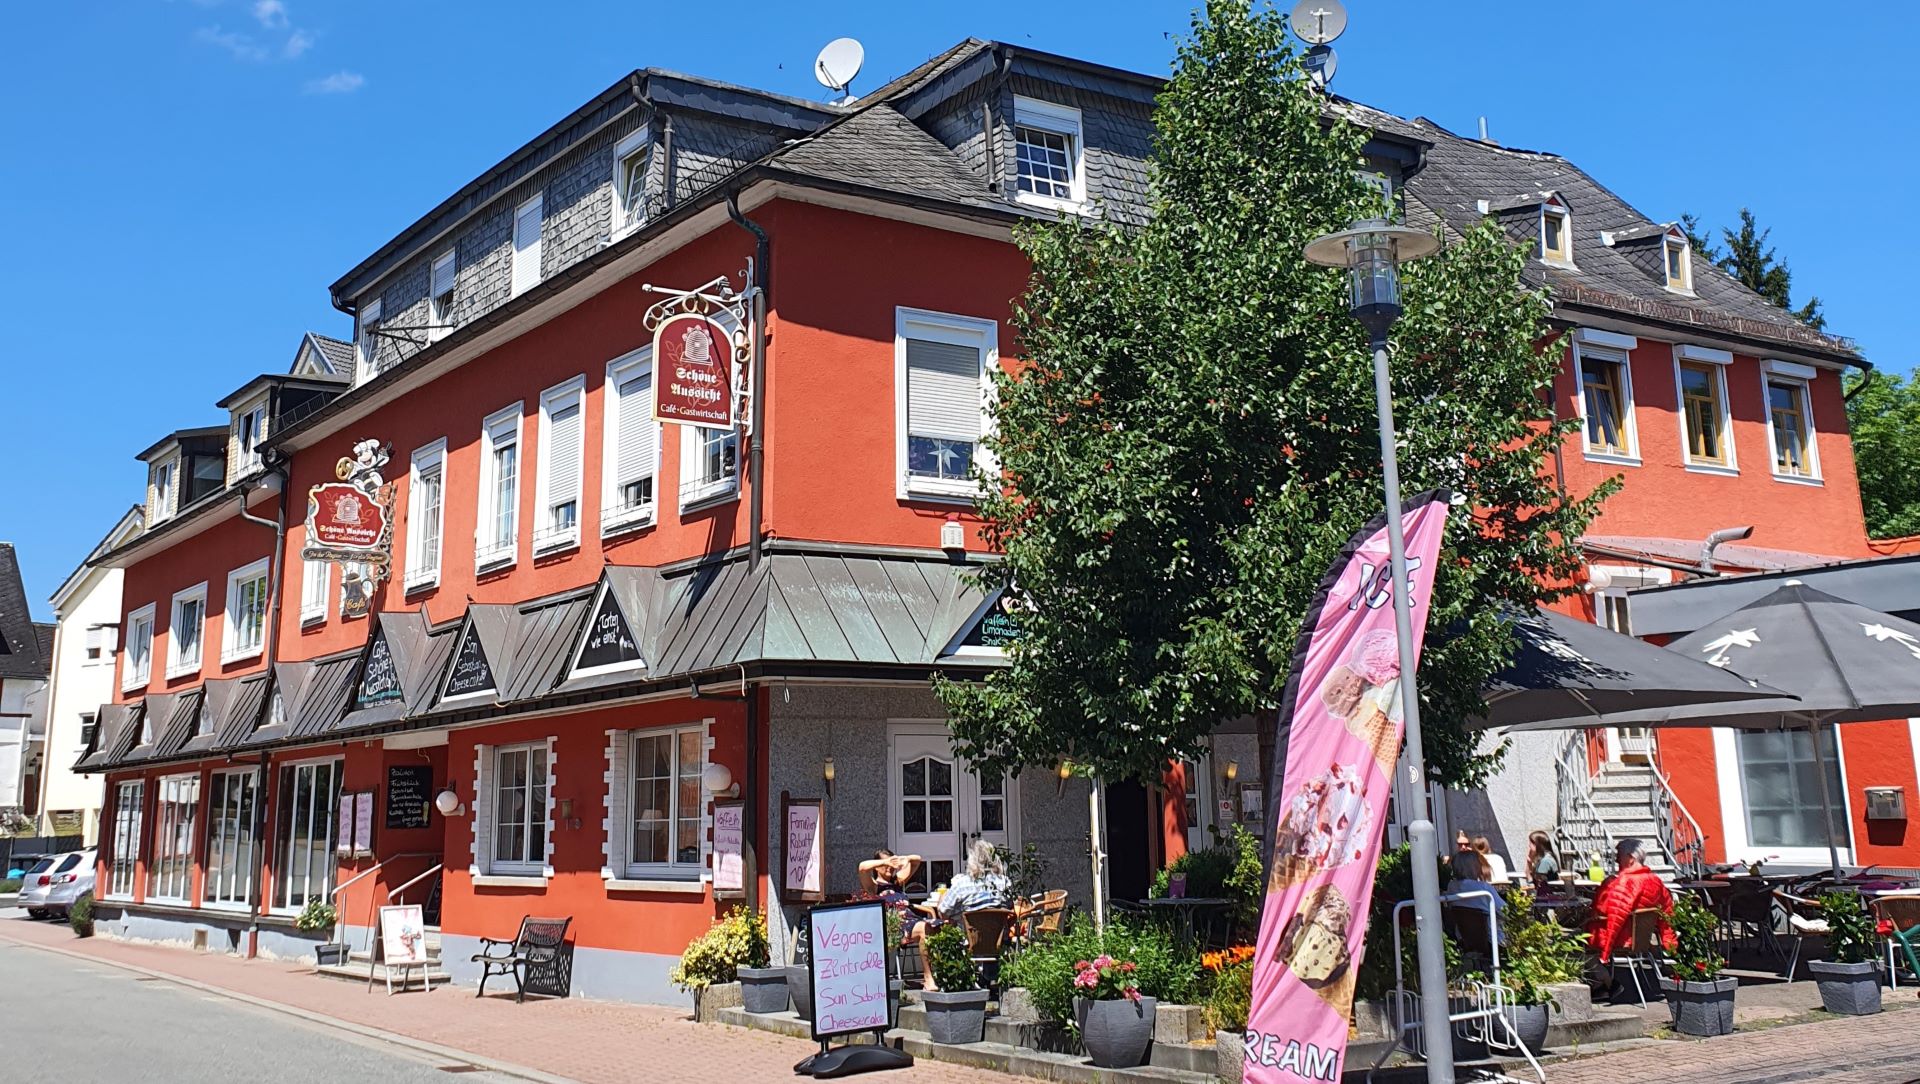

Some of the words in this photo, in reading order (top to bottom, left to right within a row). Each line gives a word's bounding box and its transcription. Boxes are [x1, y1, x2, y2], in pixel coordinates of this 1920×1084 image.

[675, 367, 717, 384] Schöne
[671, 383, 721, 402] Aussicht
[660, 403, 677, 413] Café
[679, 406, 728, 421] Gastwirtschaft
[320, 525, 344, 534] Schöne
[347, 527, 376, 537] Aussicht
[1348, 555, 1422, 611] ICE
[463, 635, 478, 655] San
[790, 832, 813, 849] Rabatt
[816, 923, 873, 953] Vegane
[820, 987, 848, 1010] San
[819, 1010, 885, 1032] Cheesecake
